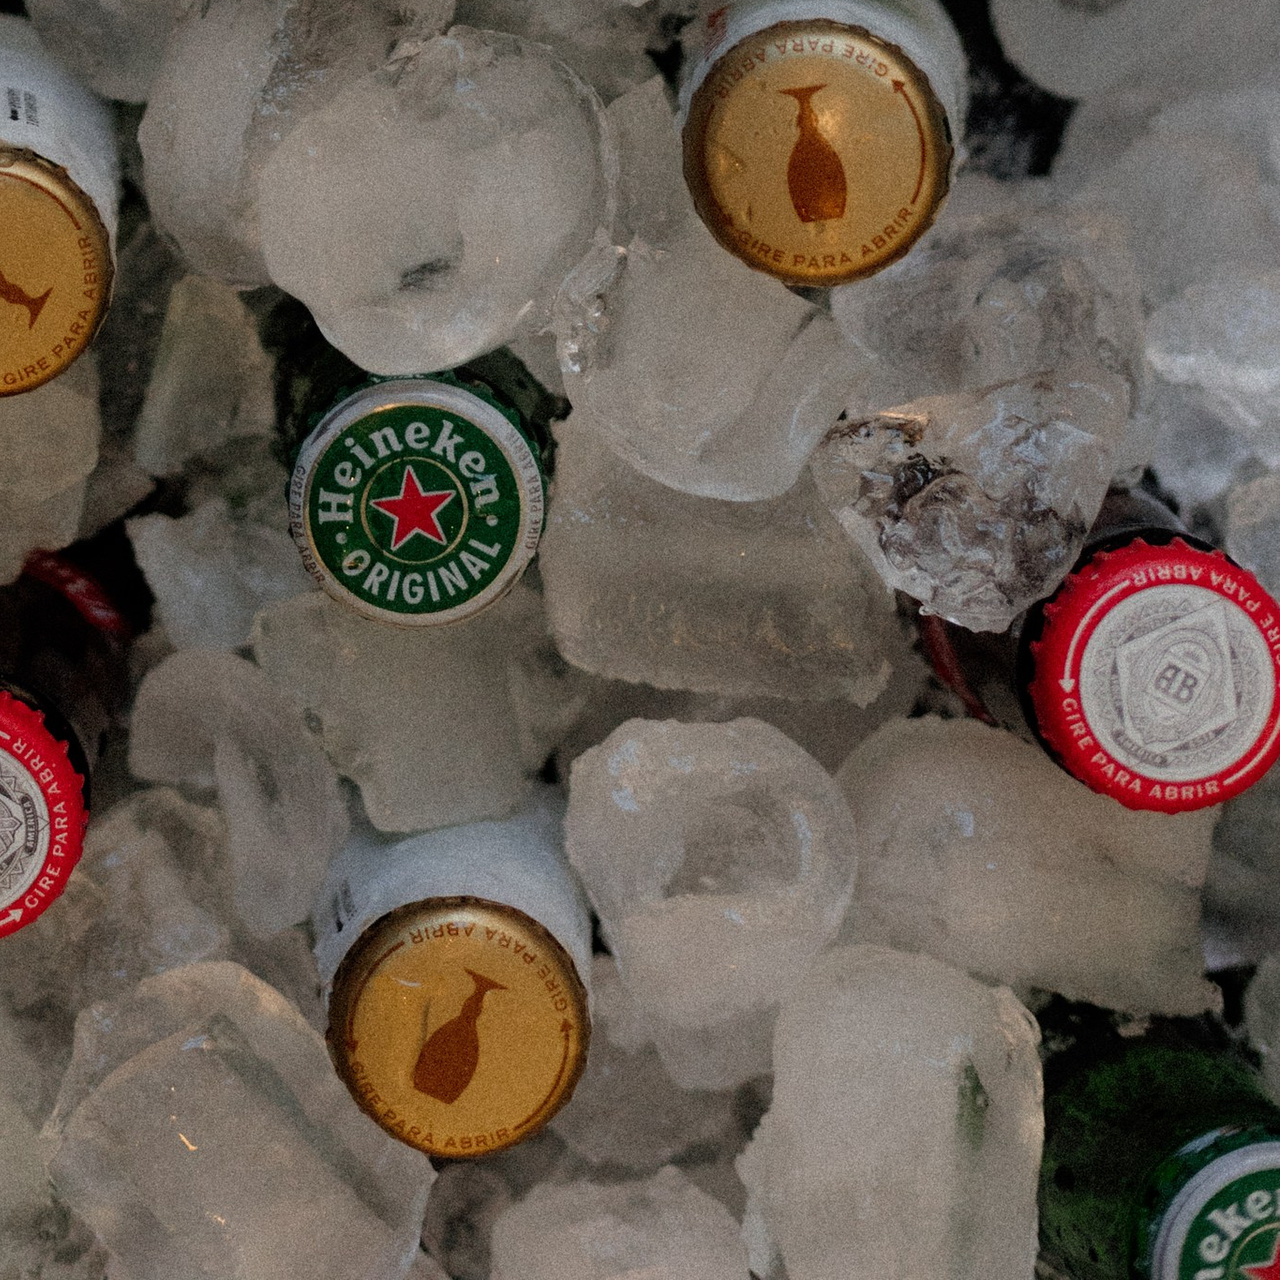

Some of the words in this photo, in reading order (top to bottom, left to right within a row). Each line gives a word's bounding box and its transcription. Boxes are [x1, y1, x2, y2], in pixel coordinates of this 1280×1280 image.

[777, 38, 834, 59] PARA
[841, 43, 891, 78] GIRE
[735, 226, 784, 264] GIRE
[793, 250, 852, 269] PARA
[858, 206, 914, 258] ABRIR
[3, 356, 51, 386] GIRE
[52, 307, 91, 359] PARA
[75, 235, 97, 299] ABRIR
[319, 418, 502, 527] Heineken
[525, 475, 542, 512] PARA
[341, 537, 502, 605] ORIGINAL
[1129, 564, 1204, 588] ABRIR
[1209, 570, 1263, 612] PARA
[11, 737, 62, 795] ABRIR
[1062, 697, 1094, 751] GIRE
[1089, 750, 1143, 793] PARA
[1150, 778, 1221, 800] ABRIR
[52, 800, 69, 858] PARA
[21, 864, 61, 910] GIRE
[408, 923, 472, 947] ABRIR
[484, 929, 537, 964] PARA
[534, 963, 570, 1011] GIRE
[349, 1060, 383, 1108] GIRE
[381, 1108, 435, 1145] PARA
[445, 1125, 511, 1148] ABRIR
